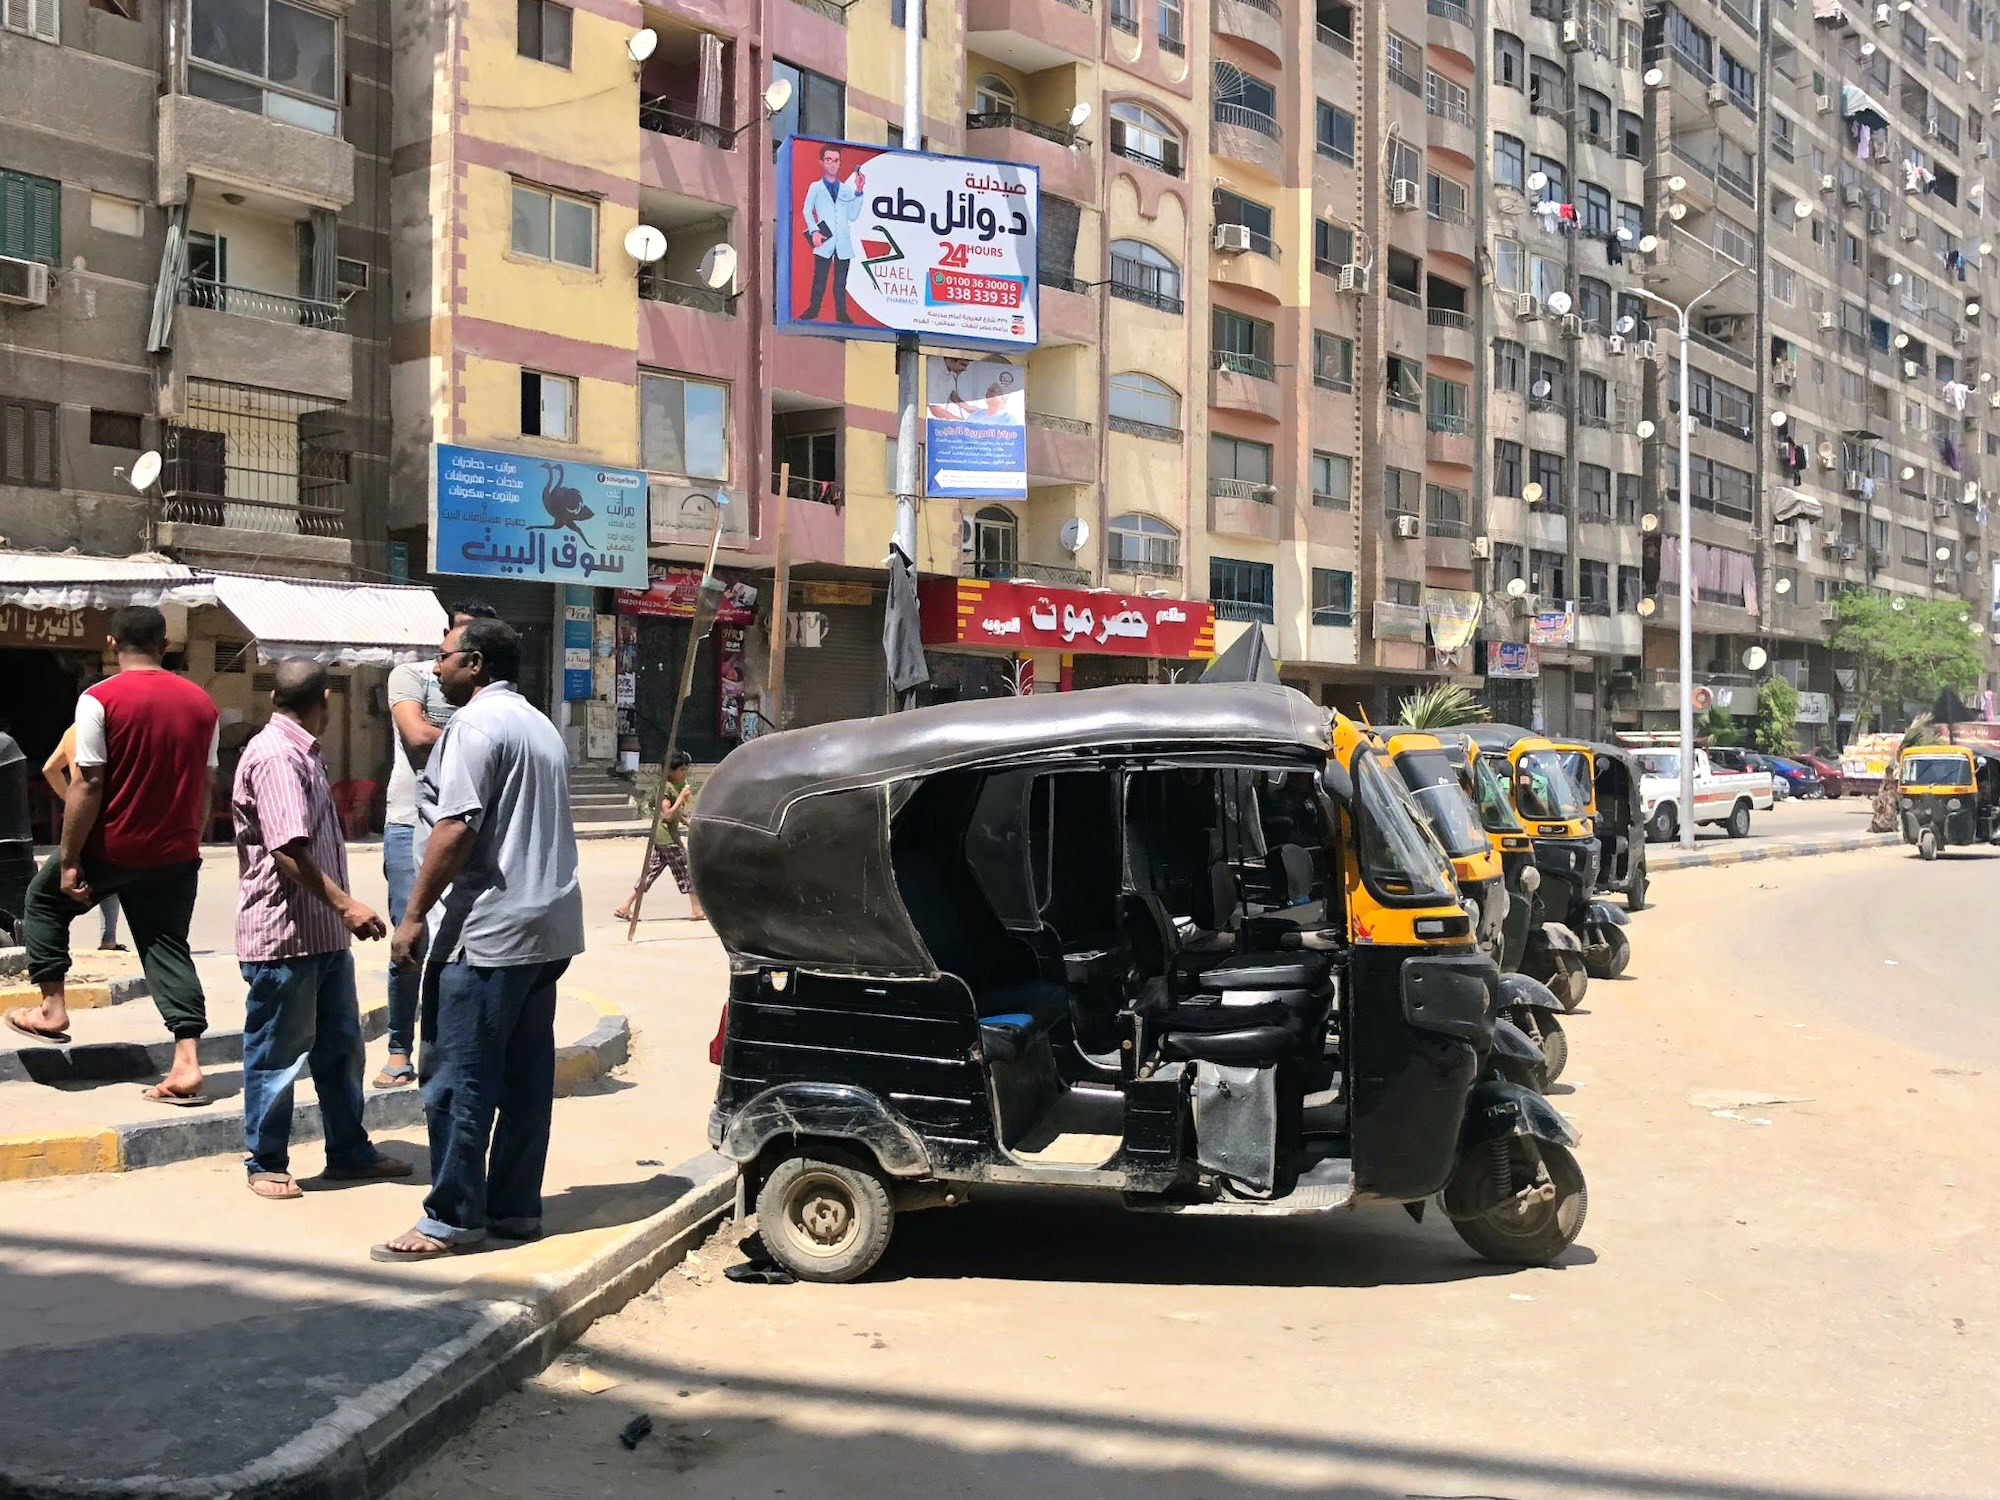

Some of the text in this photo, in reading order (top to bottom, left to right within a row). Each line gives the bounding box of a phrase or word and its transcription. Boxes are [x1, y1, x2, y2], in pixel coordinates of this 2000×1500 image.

[966, 172, 1027, 198] صيدلية
[872, 187, 926, 224] طه
[938, 242, 1003, 268] 24 HOURS
[874, 265, 914, 281] WAEL
[883, 282, 918, 297] TAHA
[946, 276, 1017, 291] 0100 36 3000 6
[946, 286, 1017, 305] 338 339 35
[495, 461, 517, 475] مراتب
[444, 470, 485, 484] مفروشات
[505, 517, 526, 527] جميع
[461, 527, 624, 578] سوق البيت
[1030, 597, 1149, 645] حضرموت
